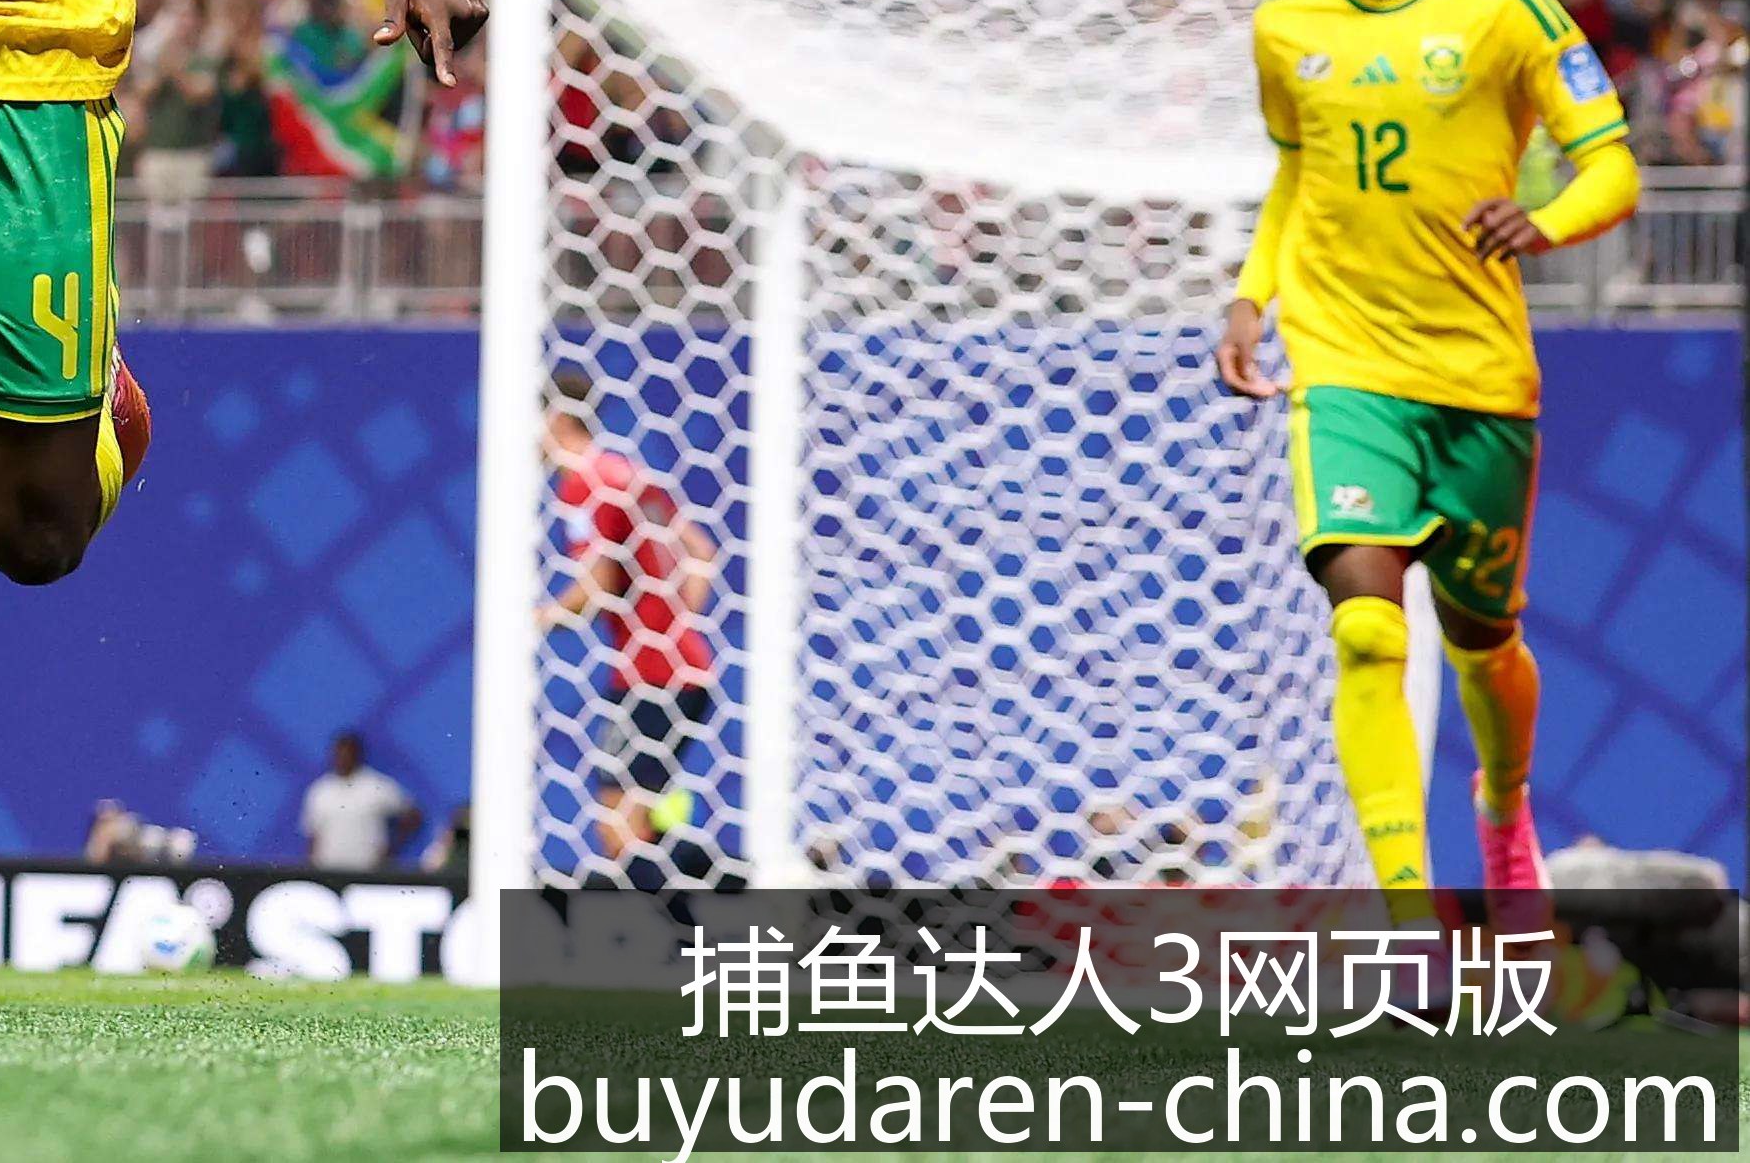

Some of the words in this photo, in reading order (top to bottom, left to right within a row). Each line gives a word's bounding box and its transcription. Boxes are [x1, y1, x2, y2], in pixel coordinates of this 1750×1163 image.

[1350, 121, 1410, 193] 12
[32, 272, 80, 380] 4
[1453, 520, 1519, 598] 12
